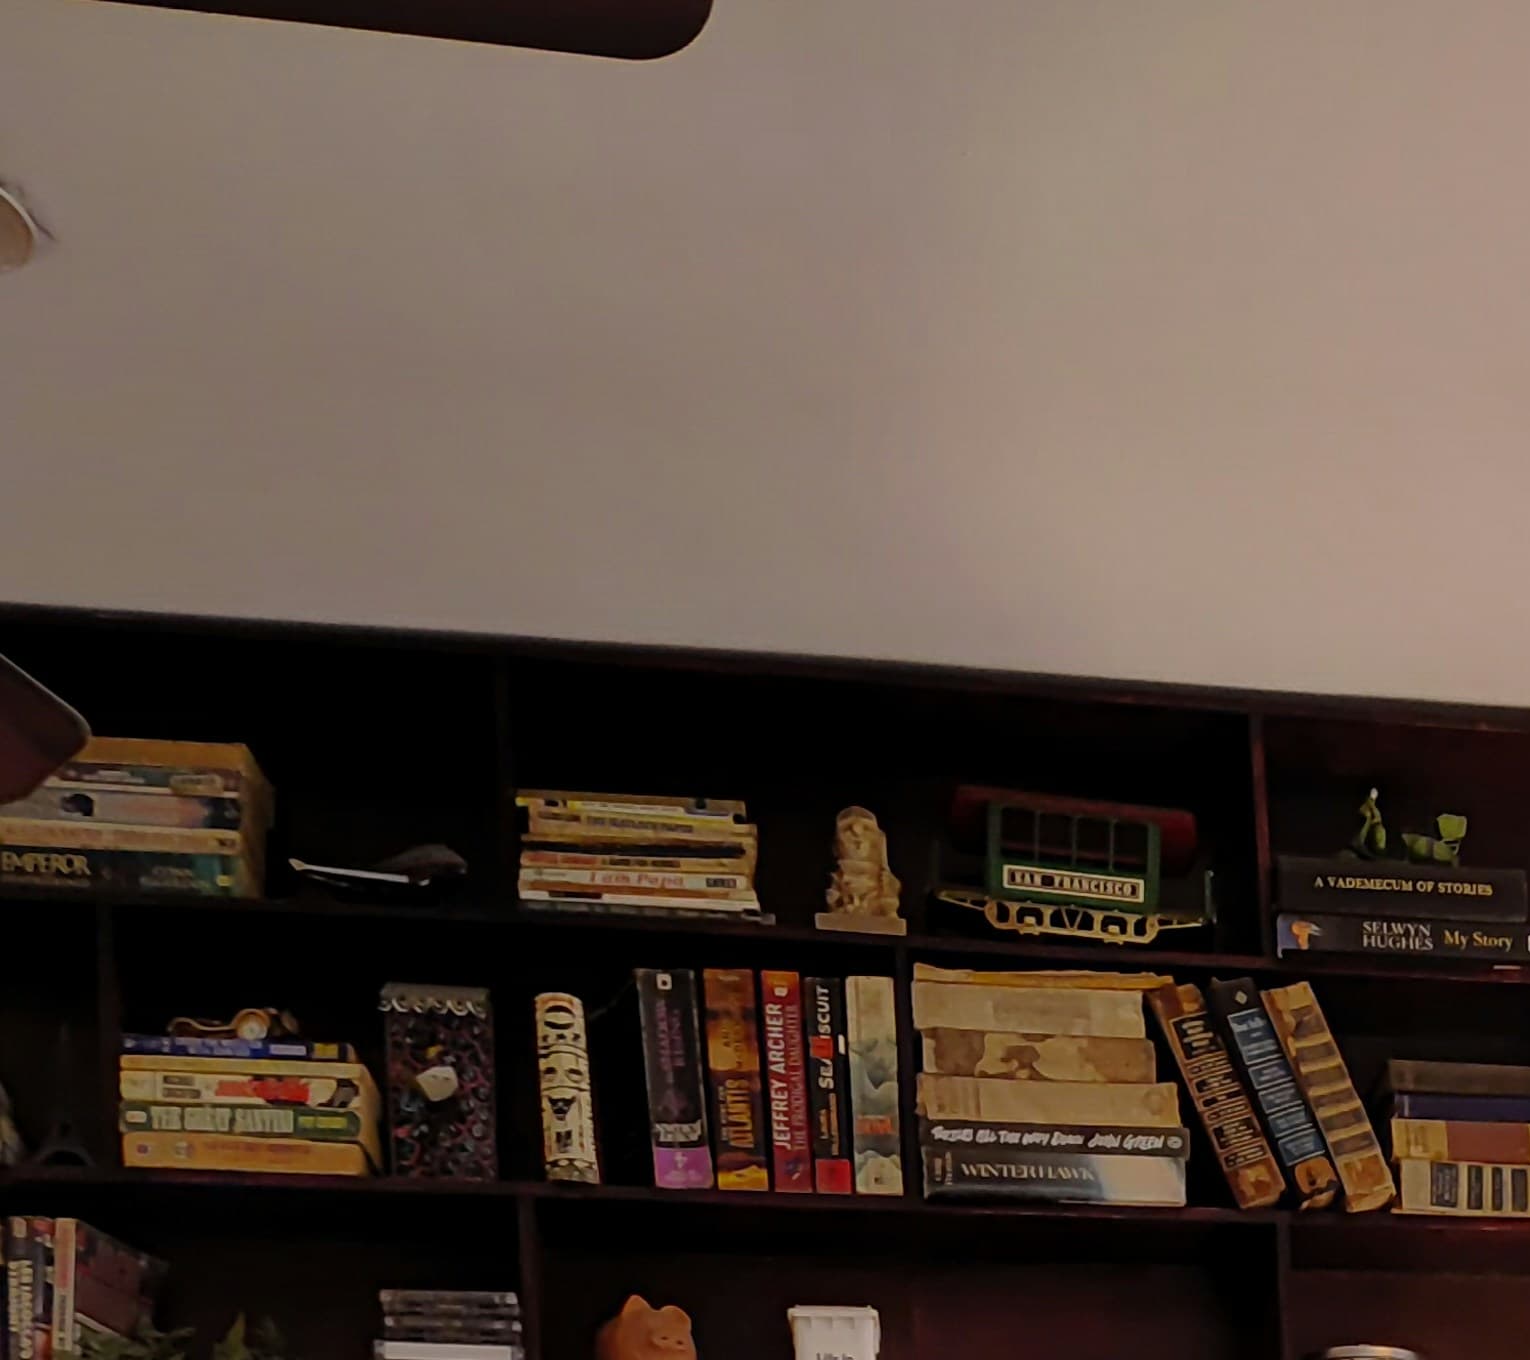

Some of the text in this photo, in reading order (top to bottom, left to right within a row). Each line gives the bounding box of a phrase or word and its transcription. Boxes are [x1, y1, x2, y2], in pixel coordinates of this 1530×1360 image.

[1, 851, 91, 876] EMPEROR
[1326, 877, 1413, 893] VADEMECUM
[1416, 880, 1435, 893] OF
[1437, 881, 1494, 897] STORIES
[1443, 929, 1514, 953] My Story
[764, 1002, 792, 1151] JEFFREY ARCHER
